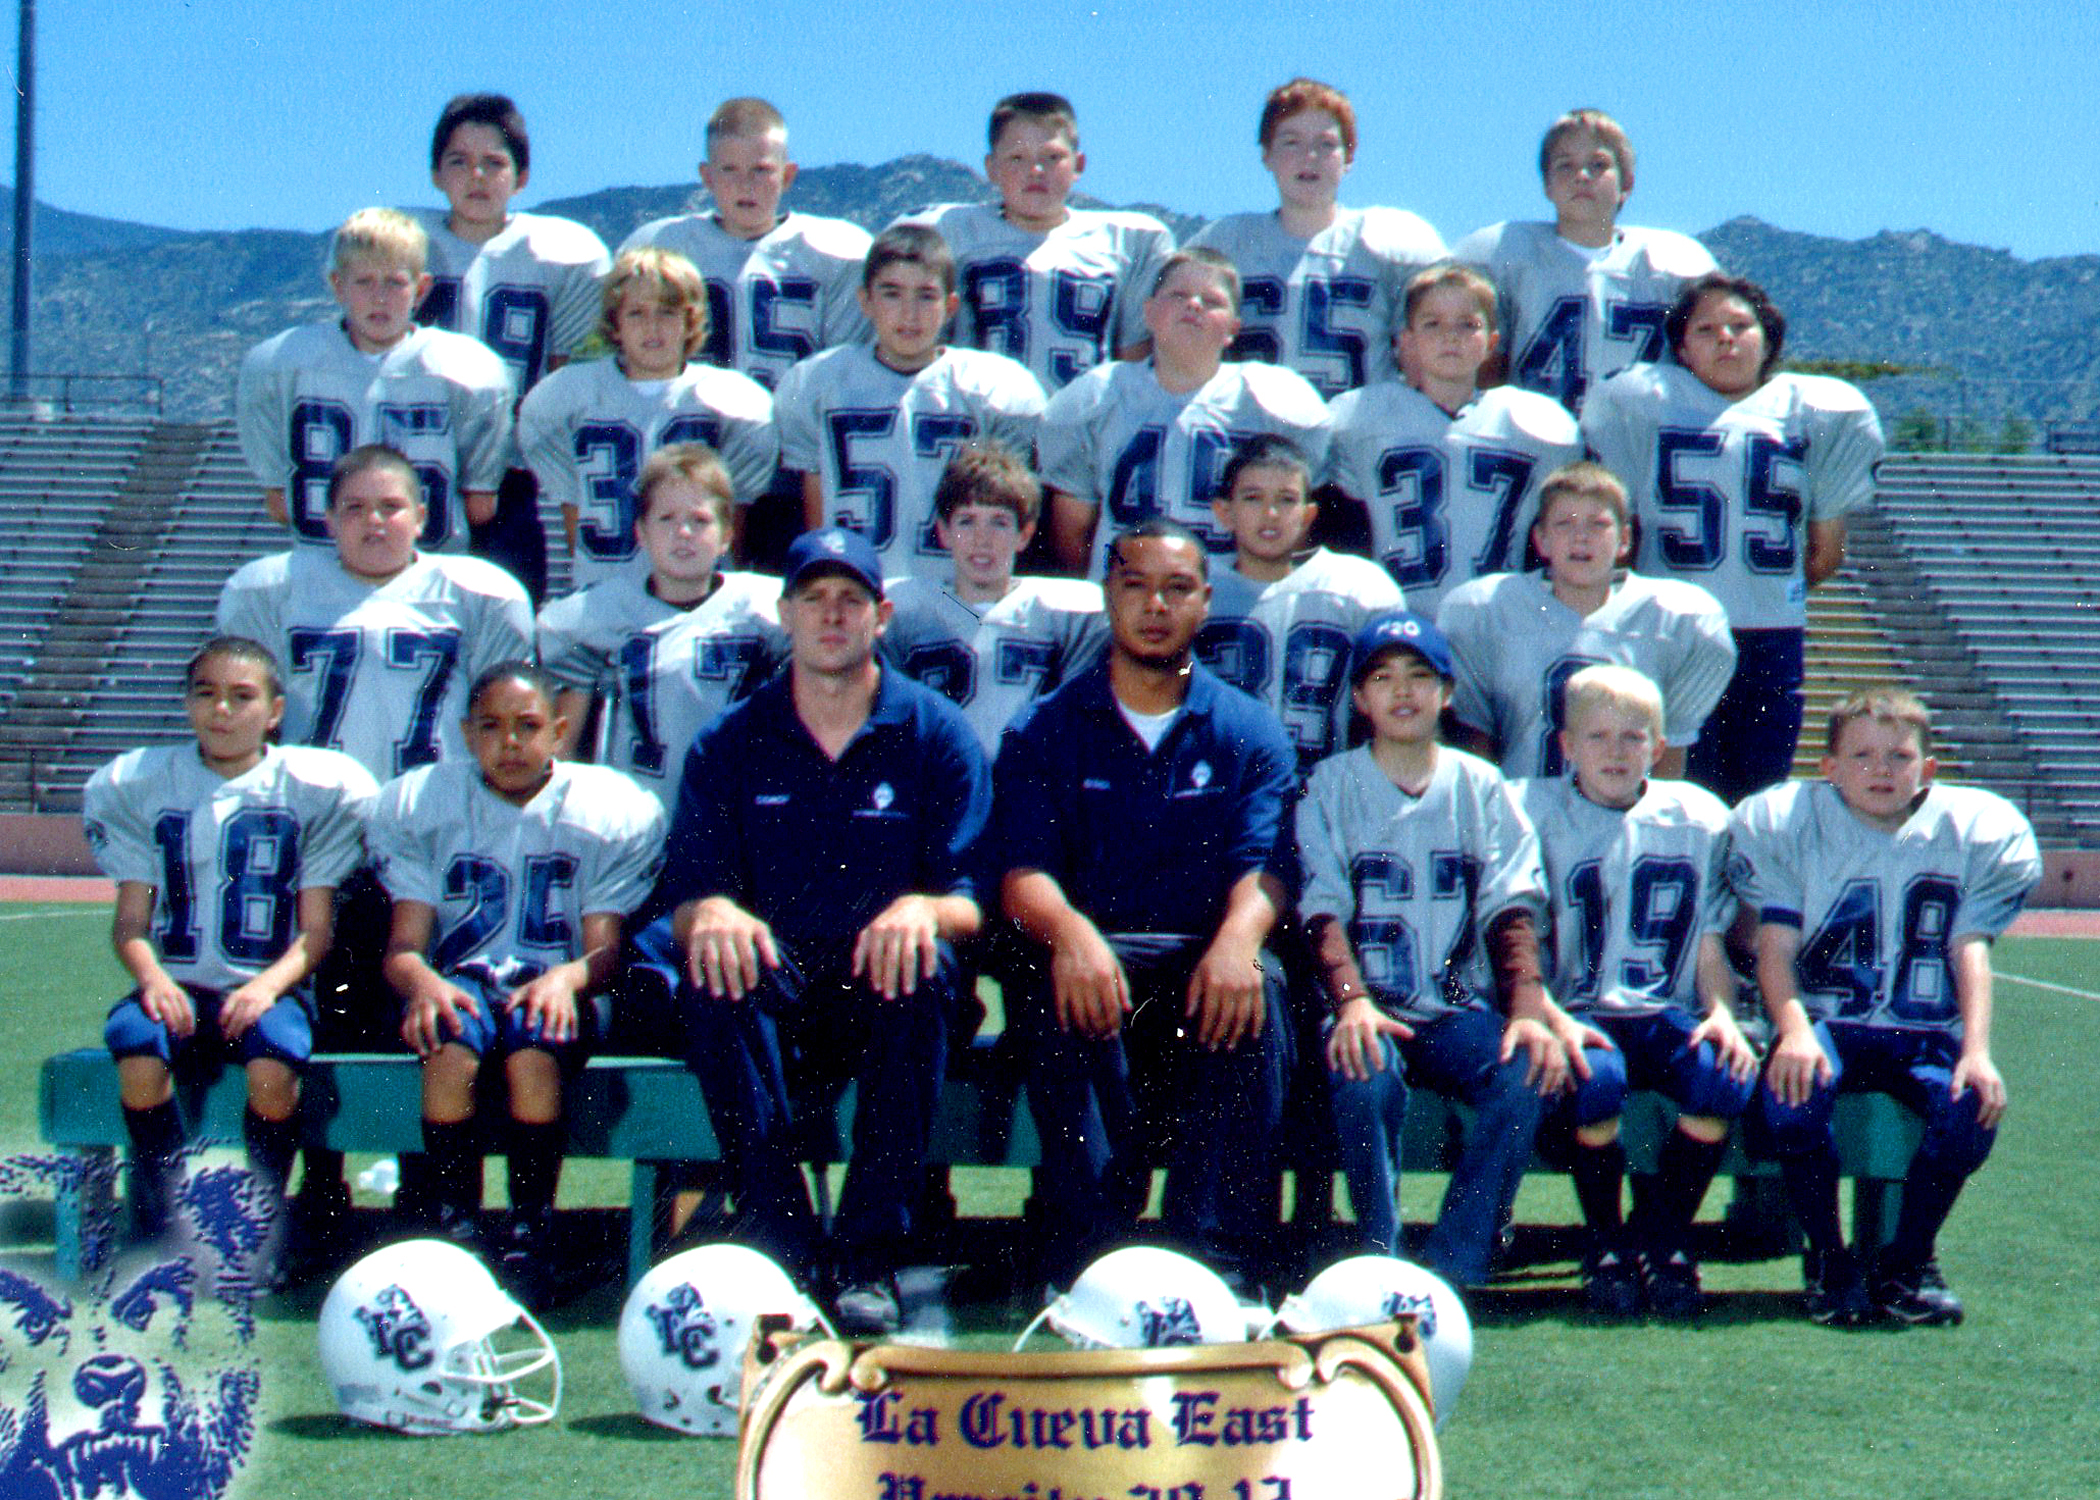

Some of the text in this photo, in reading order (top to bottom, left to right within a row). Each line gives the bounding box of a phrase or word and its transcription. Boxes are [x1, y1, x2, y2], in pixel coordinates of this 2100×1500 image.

[961, 256, 1114, 388] 89
[1516, 294, 1674, 412] 47
[572, 414, 722, 563] 3
[826, 407, 975, 556] 57
[1373, 445, 1537, 590] 37
[1654, 426, 1808, 574] 55
[286, 625, 462, 776] 77
[617, 631, 766, 777] 17
[150, 806, 300, 966] 18
[1350, 850, 1485, 1005] 67
[1565, 855, 1698, 1000] 19
[1801, 872, 1961, 1027] 48
